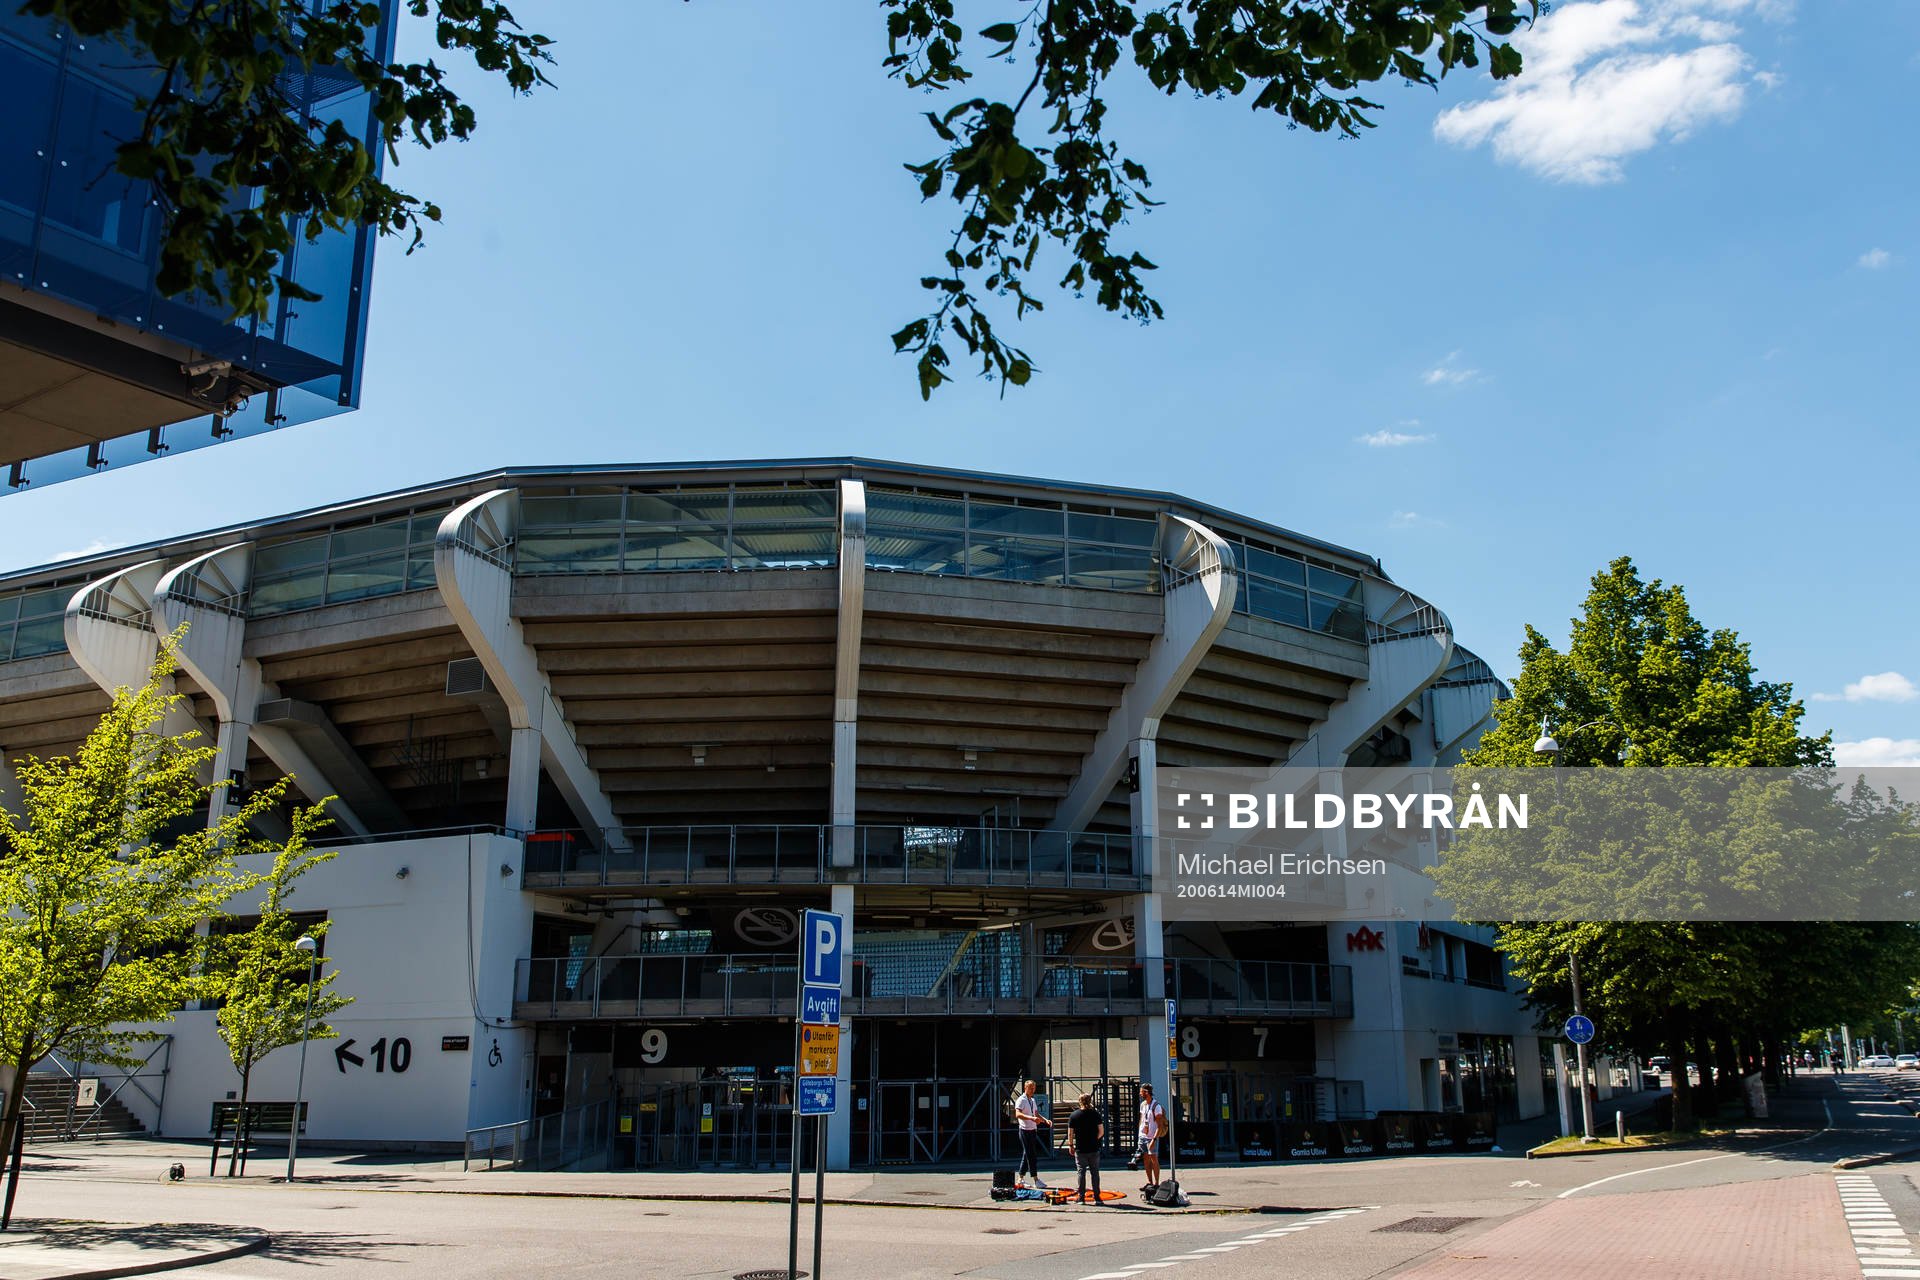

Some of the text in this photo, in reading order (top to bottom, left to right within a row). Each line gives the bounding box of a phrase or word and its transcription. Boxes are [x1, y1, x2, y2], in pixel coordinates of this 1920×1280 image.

[814, 919, 837, 977] P
[807, 995, 837, 1014] Avgift
[641, 1029, 668, 1064] 9
[808, 1046, 837, 1055] markerad
[812, 1031, 834, 1041] Utanför
[1182, 1026, 1201, 1058] 8
[1253, 1027, 1269, 1058] 7
[370, 1037, 412, 1074] 10
[814, 1058, 832, 1070] plat
